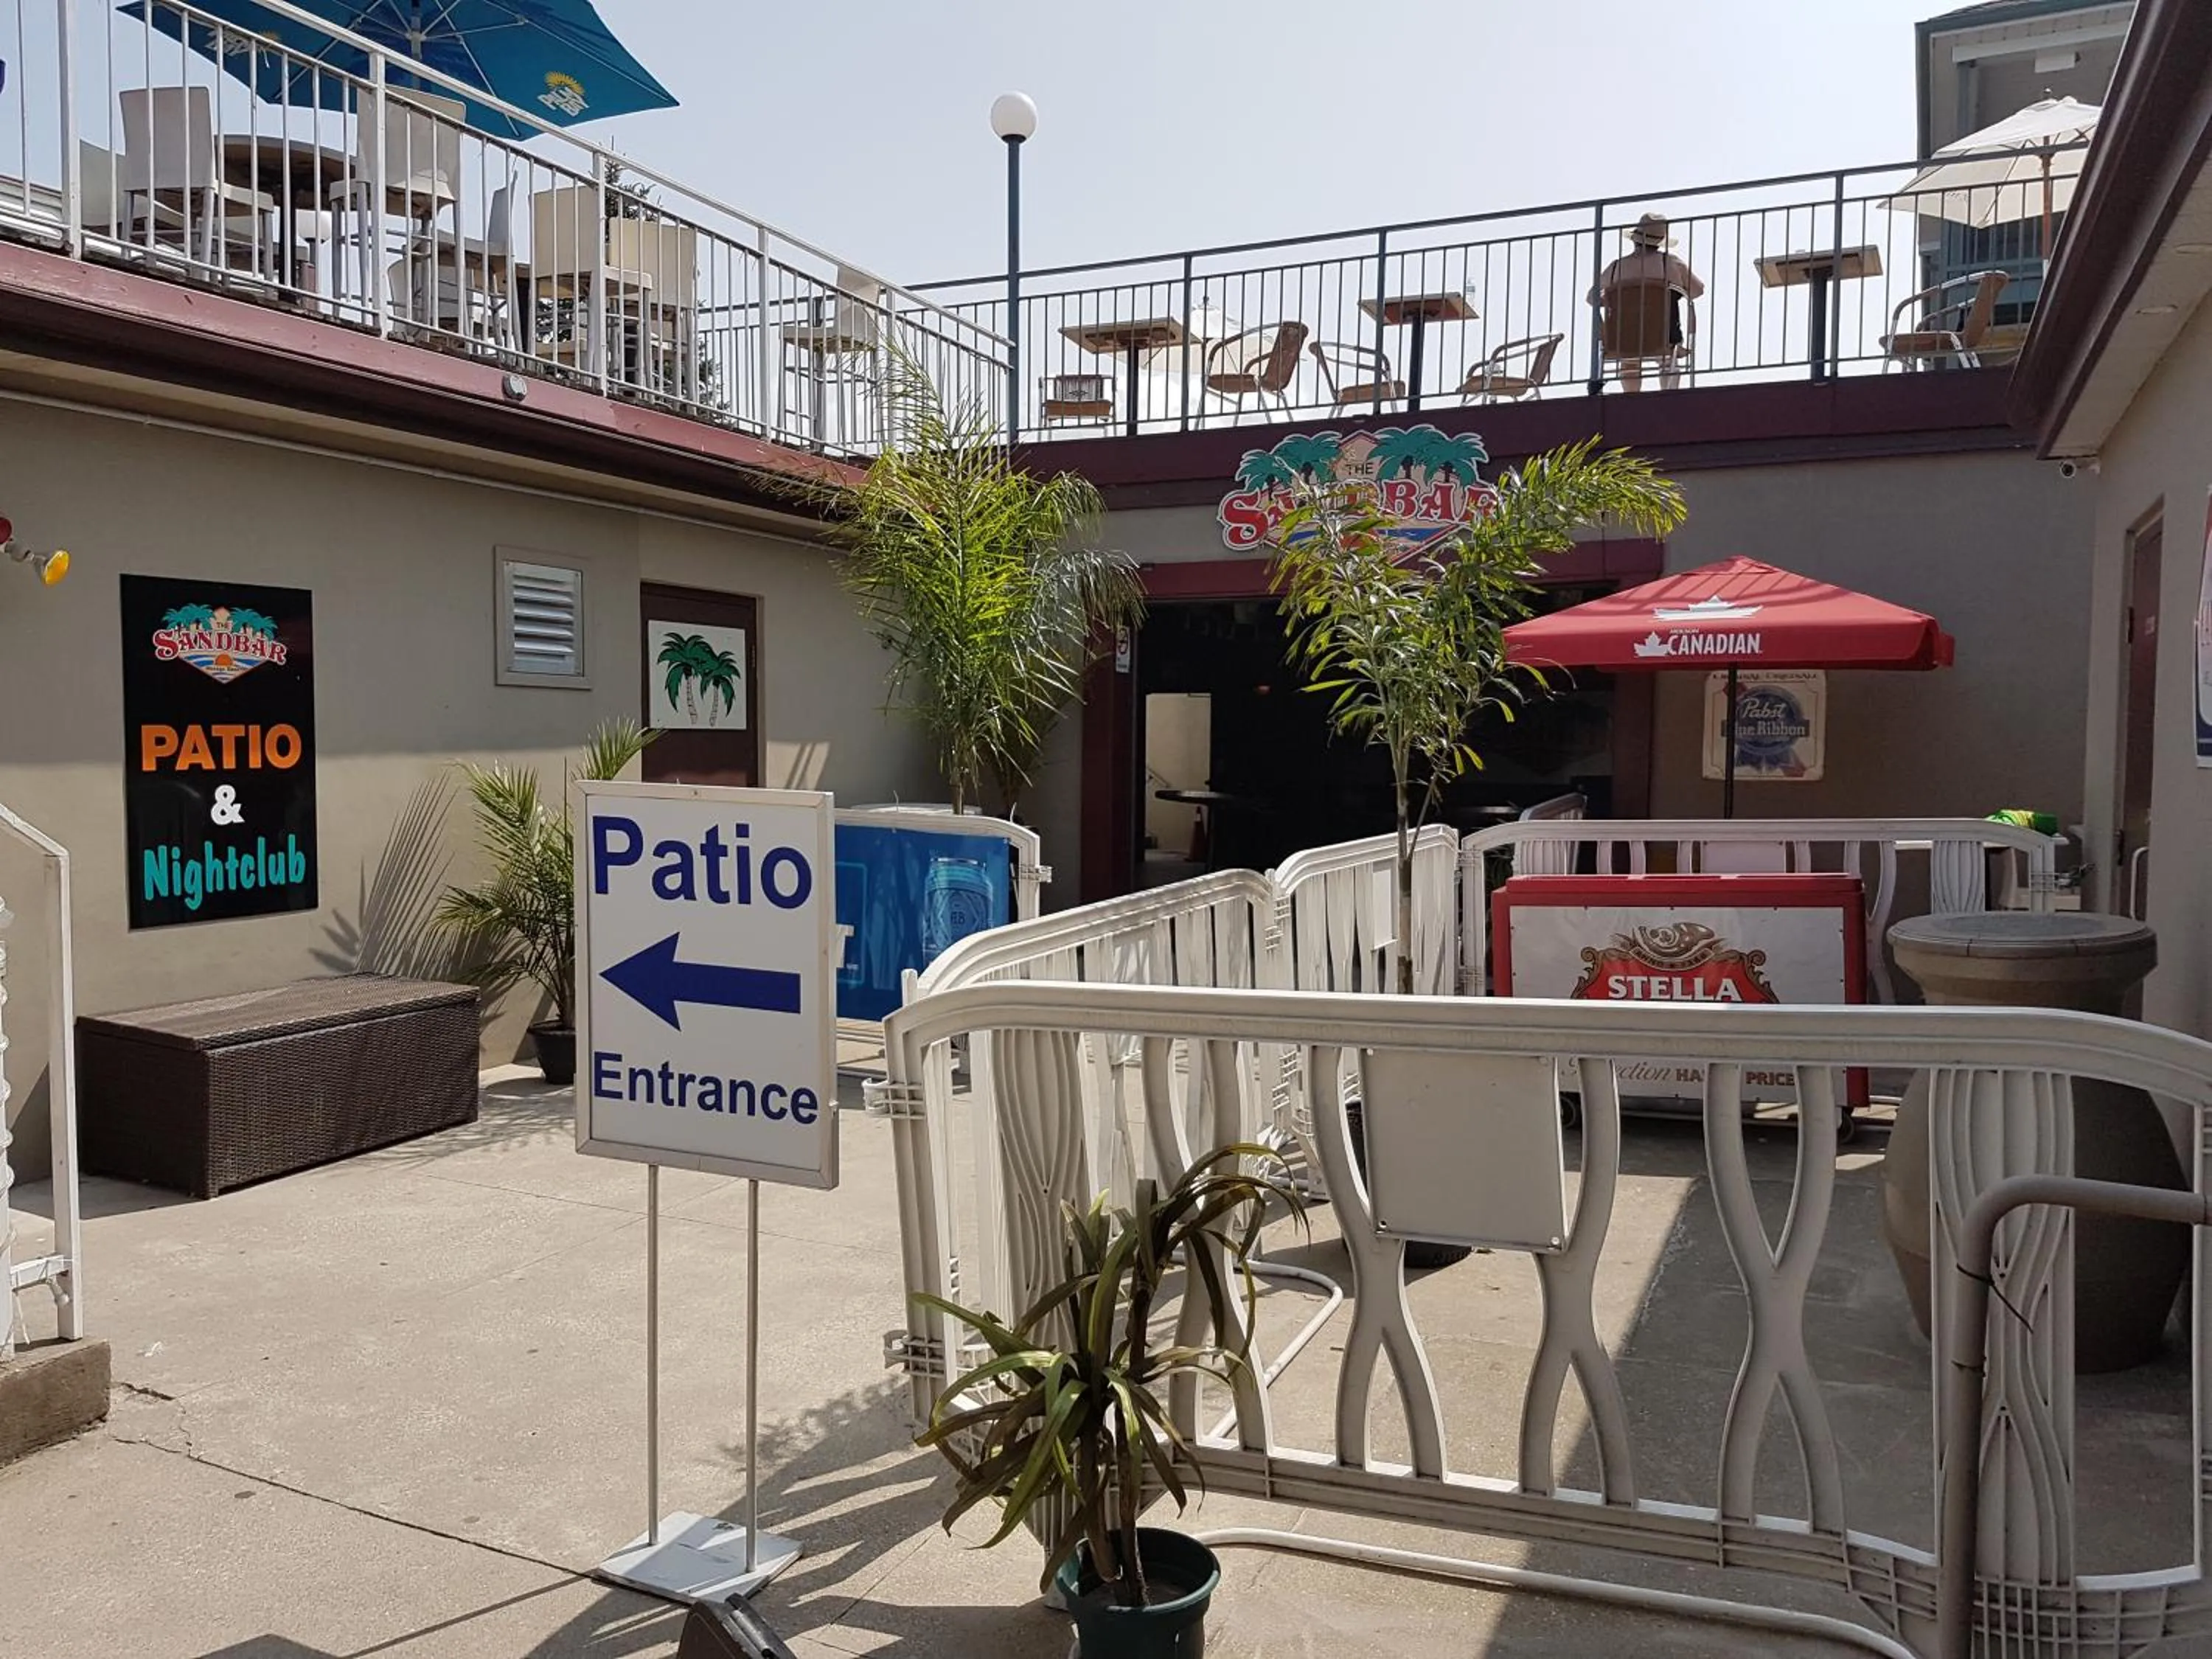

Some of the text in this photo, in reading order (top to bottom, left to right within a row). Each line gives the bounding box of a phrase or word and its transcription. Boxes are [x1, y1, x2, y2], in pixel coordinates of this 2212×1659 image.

[1345, 462, 1374, 476] THE
[153, 629, 287, 664] SANDBAR
[1668, 633, 1761, 655] CANADIAN
[1741, 695, 1787, 719] Pabst
[1756, 720, 1806, 736] Ribbon
[141, 723, 302, 771] PATIO
[210, 785, 245, 826] &
[144, 834, 305, 910] Nightclub
[592, 815, 813, 909] Patio
[1607, 975, 1743, 1003] STELLA
[593, 1051, 818, 1124] Entrance
[1745, 1071, 1795, 1087] PRICE
